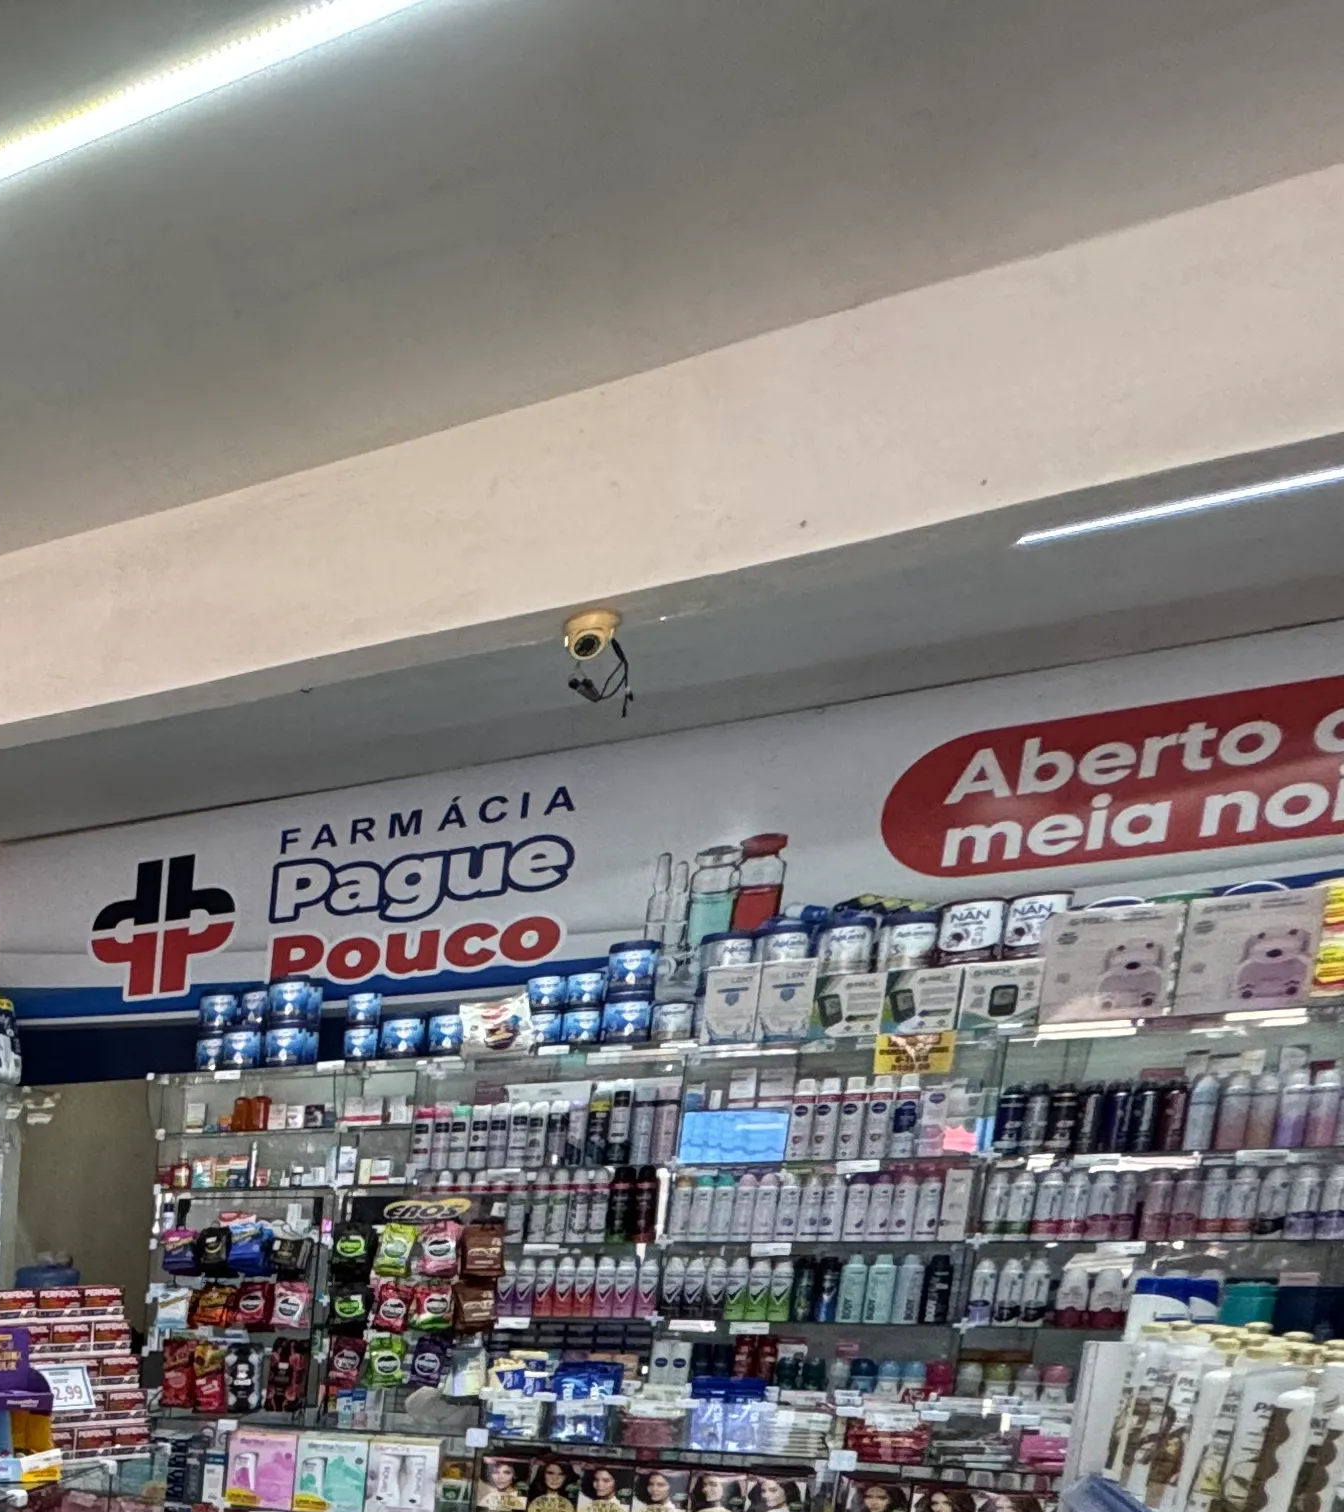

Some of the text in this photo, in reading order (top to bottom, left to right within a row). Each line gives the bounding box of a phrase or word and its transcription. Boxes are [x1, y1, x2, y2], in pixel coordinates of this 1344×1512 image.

[943, 719, 1283, 806] Aberto
[279, 785, 577, 855] FARMÁCIA
[940, 794, 1172, 868] meia
[269, 834, 576, 924] Pague
